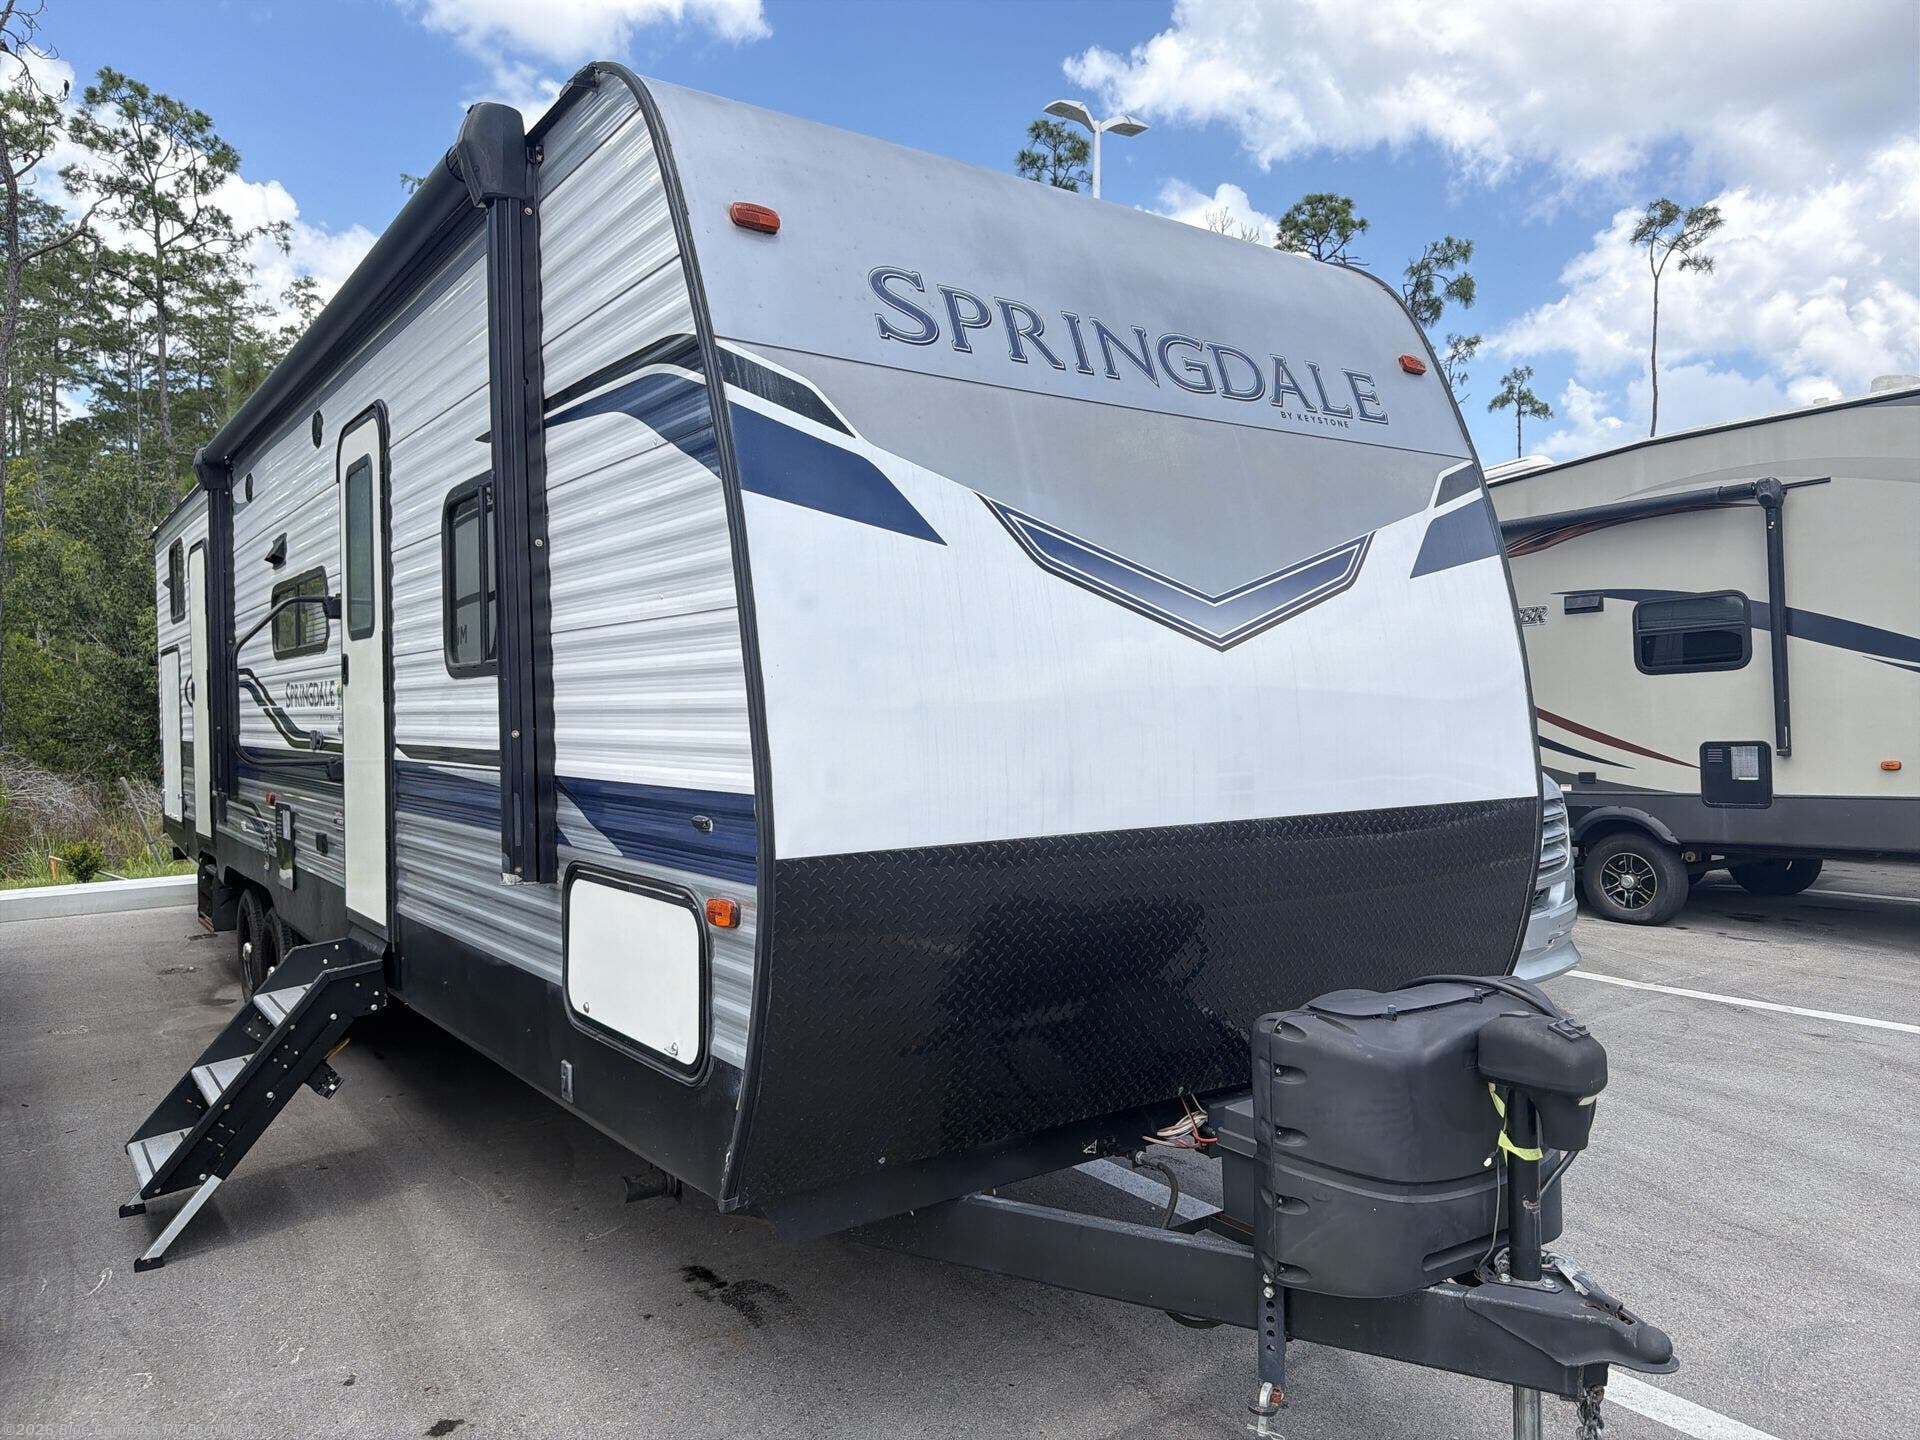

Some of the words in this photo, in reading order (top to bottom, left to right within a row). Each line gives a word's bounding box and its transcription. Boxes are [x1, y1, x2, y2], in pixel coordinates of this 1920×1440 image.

[868, 265, 1388, 425] SPRINGDALE
[1281, 411, 1292, 420] BY
[1297, 414, 1349, 428] KEYSTONE
[286, 681, 335, 708] SPRINGDALE
